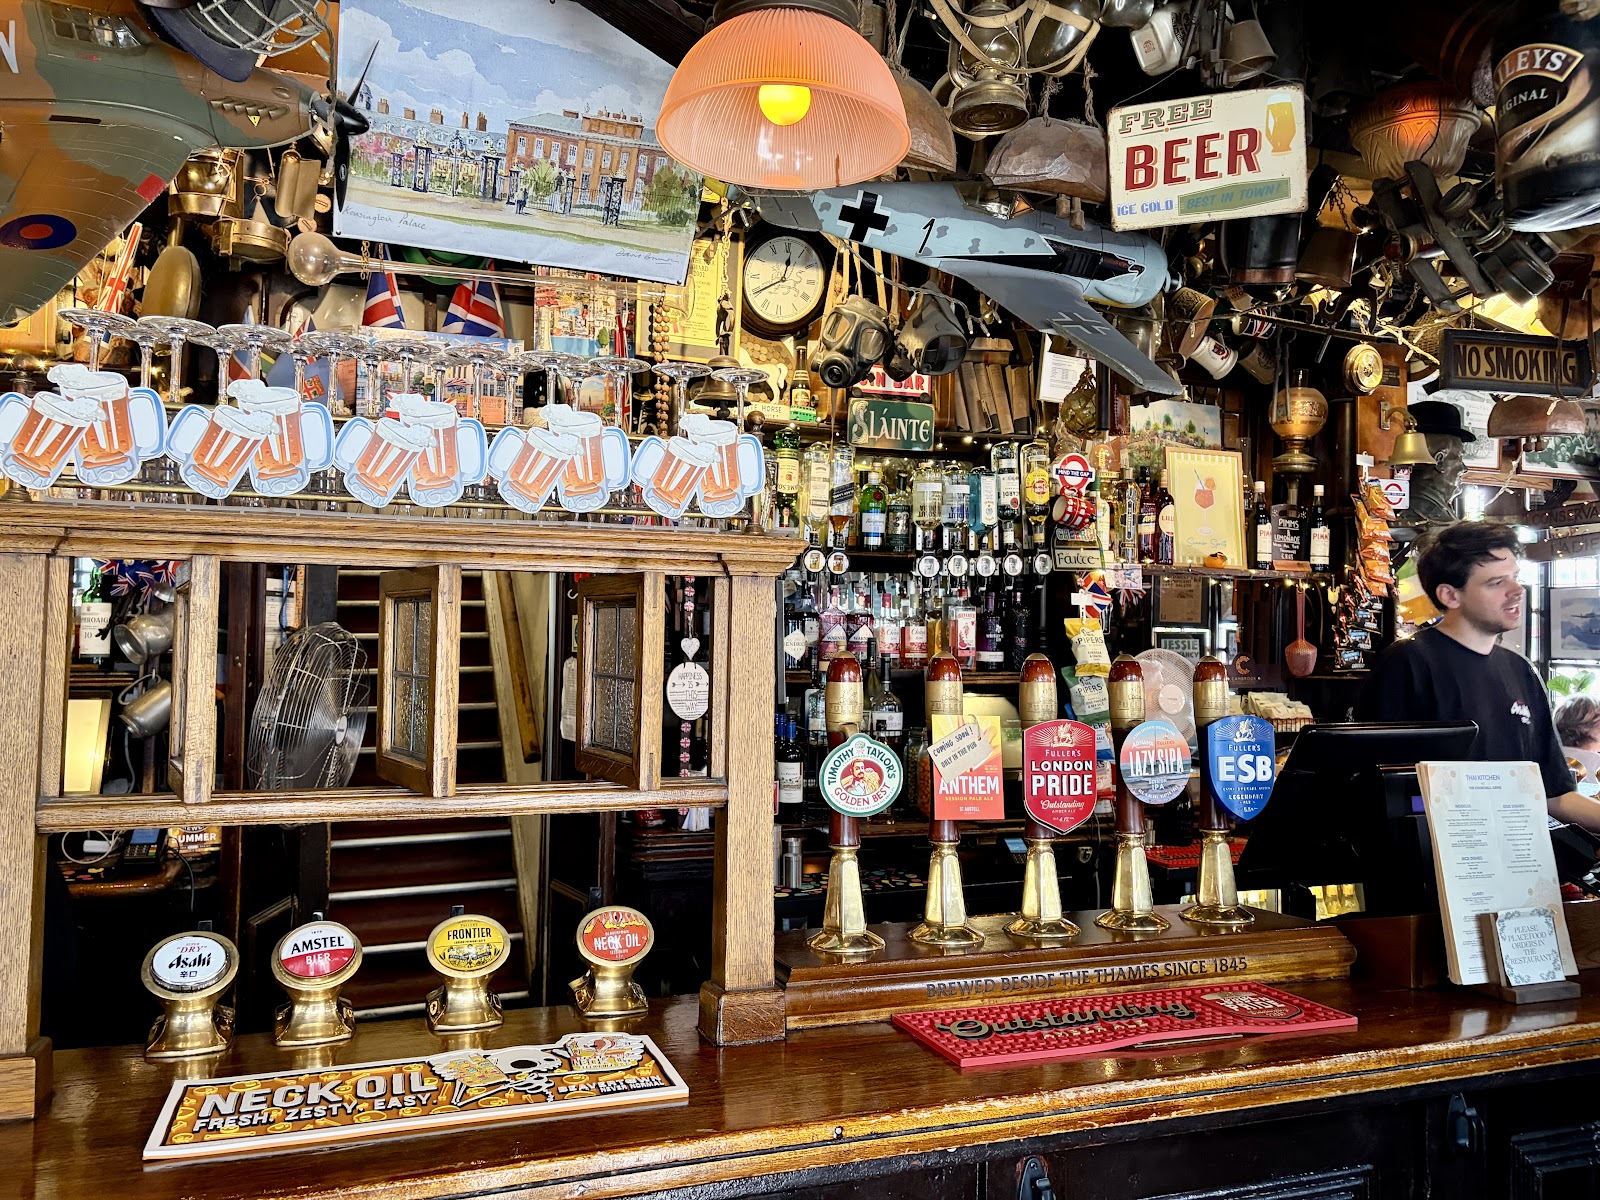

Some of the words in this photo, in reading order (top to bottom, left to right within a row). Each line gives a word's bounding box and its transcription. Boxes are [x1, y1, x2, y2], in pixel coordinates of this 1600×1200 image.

[1118, 98, 1213, 134] FREE
[1125, 127, 1263, 193] BEER
[1186, 194, 1216, 210] BEST
[1220, 191, 1236, 203] IN
[1239, 183, 1282, 200] TOWN!
[1117, 203, 1138, 217] ICE
[1141, 199, 1174, 214] COLD
[342, 205, 393, 227] Kensington
[398, 212, 427, 231] Palace
[1455, 344, 1481, 377] NO
[851, 400, 931, 443] SLÁINTE
[1057, 468, 1071, 476] MIND
[1070, 469, 1081, 477] THE
[1080, 470, 1090, 478] GAP
[1278, 518, 1300, 528] PIMMS
[1162, 639, 1199, 650] JESSIE
[1077, 683, 1104, 696] PIPERS
[932, 739, 954, 757] COMING
[940, 758, 953, 768] ONLY
[959, 749, 968, 758] THE
[967, 741, 978, 752] PUB
[1045, 748, 1081, 758] FULLER'S
[1228, 744, 1261, 752] FULLER'S
[828, 747, 855, 786] TIMOTHY
[866, 746, 897, 780] TAYLOR'S
[1031, 760, 1093, 772] LONDON
[1129, 749, 1155, 777] LAZY
[1157, 747, 1184, 774] SIPA
[1217, 753, 1273, 783] ESB
[938, 776, 1000, 795] ANTHEM
[1031, 774, 1093, 796] PRIDE
[834, 787, 870, 807] GOLDEN
[871, 782, 891, 803] BEST
[1040, 800, 1085, 811] Outstanding
[171, 832, 217, 844] SUMMER
[447, 927, 492, 940] FRONTIER
[1508, 933, 1529, 942] PLACE
[1529, 931, 1547, 940] FOOD
[1513, 924, 1539, 934] PLEASE
[291, 936, 344, 955] AMSTEL
[594, 934, 623, 951] NECK
[625, 933, 641, 948] OIL
[1511, 940, 1538, 949] ORDERS
[1537, 939, 1546, 947] IN
[168, 952, 212, 969] Asahi
[305, 952, 331, 965] BIER
[1510, 953, 1552, 965] RESTAURANT
[1523, 948, 1537, 956] THE
[180, 970, 198, 979] 辛口
[927, 978, 996, 999] BREWED
[1001, 973, 1056, 993] BESIDE
[1059, 969, 1090, 987] THE
[1093, 963, 1160, 984] THAMES
[1163, 959, 1208, 978] SINCE
[1212, 956, 1248, 973] 1845
[937, 1001, 1191, 1041] Outstanding
[557, 1074, 662, 1093] BEAVERTOWN
[599, 1084, 628, 1093] NEVER
[629, 1079, 665, 1090] NORMAL
[198, 1079, 344, 1118] NECK
[356, 1071, 439, 1099] OIL
[193, 1111, 275, 1132] FRESH.
[286, 1101, 364, 1121] ZESTY.
[373, 1093, 438, 1110] EASY.
